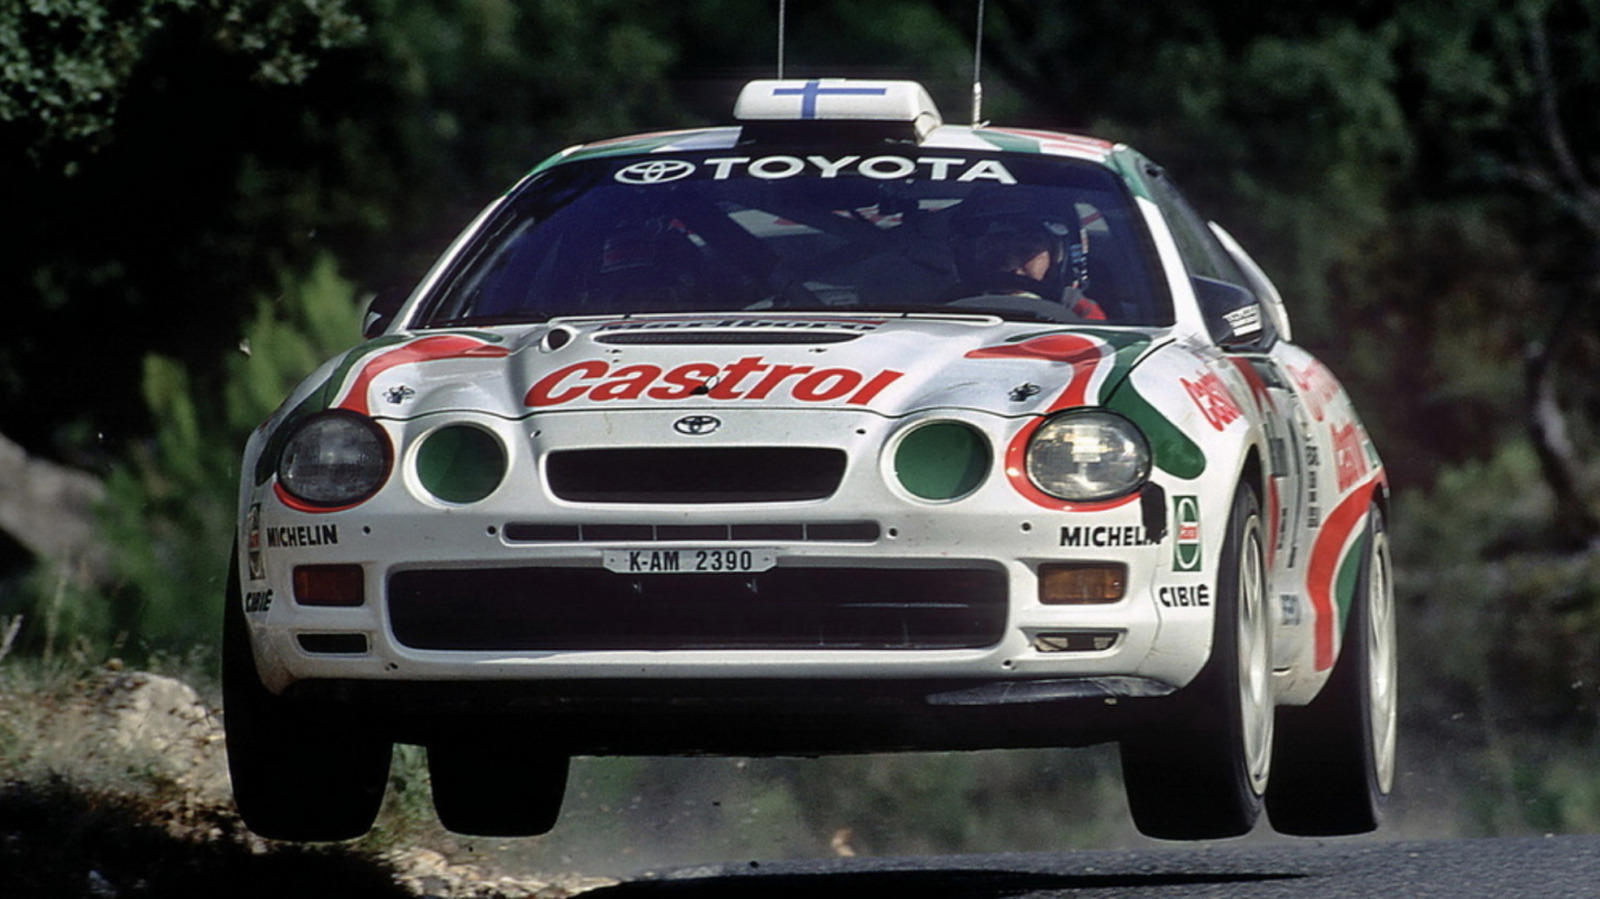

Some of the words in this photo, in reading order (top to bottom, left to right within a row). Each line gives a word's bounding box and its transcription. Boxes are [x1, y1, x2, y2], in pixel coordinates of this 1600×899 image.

[704, 155, 1017, 185] TOYOTA
[524, 356, 904, 407] Castrol
[266, 524, 339, 548] MICHELIN
[1060, 526, 1161, 547] MICHEL
[629, 551, 680, 571] K-AM
[695, 550, 752, 571] 2390
